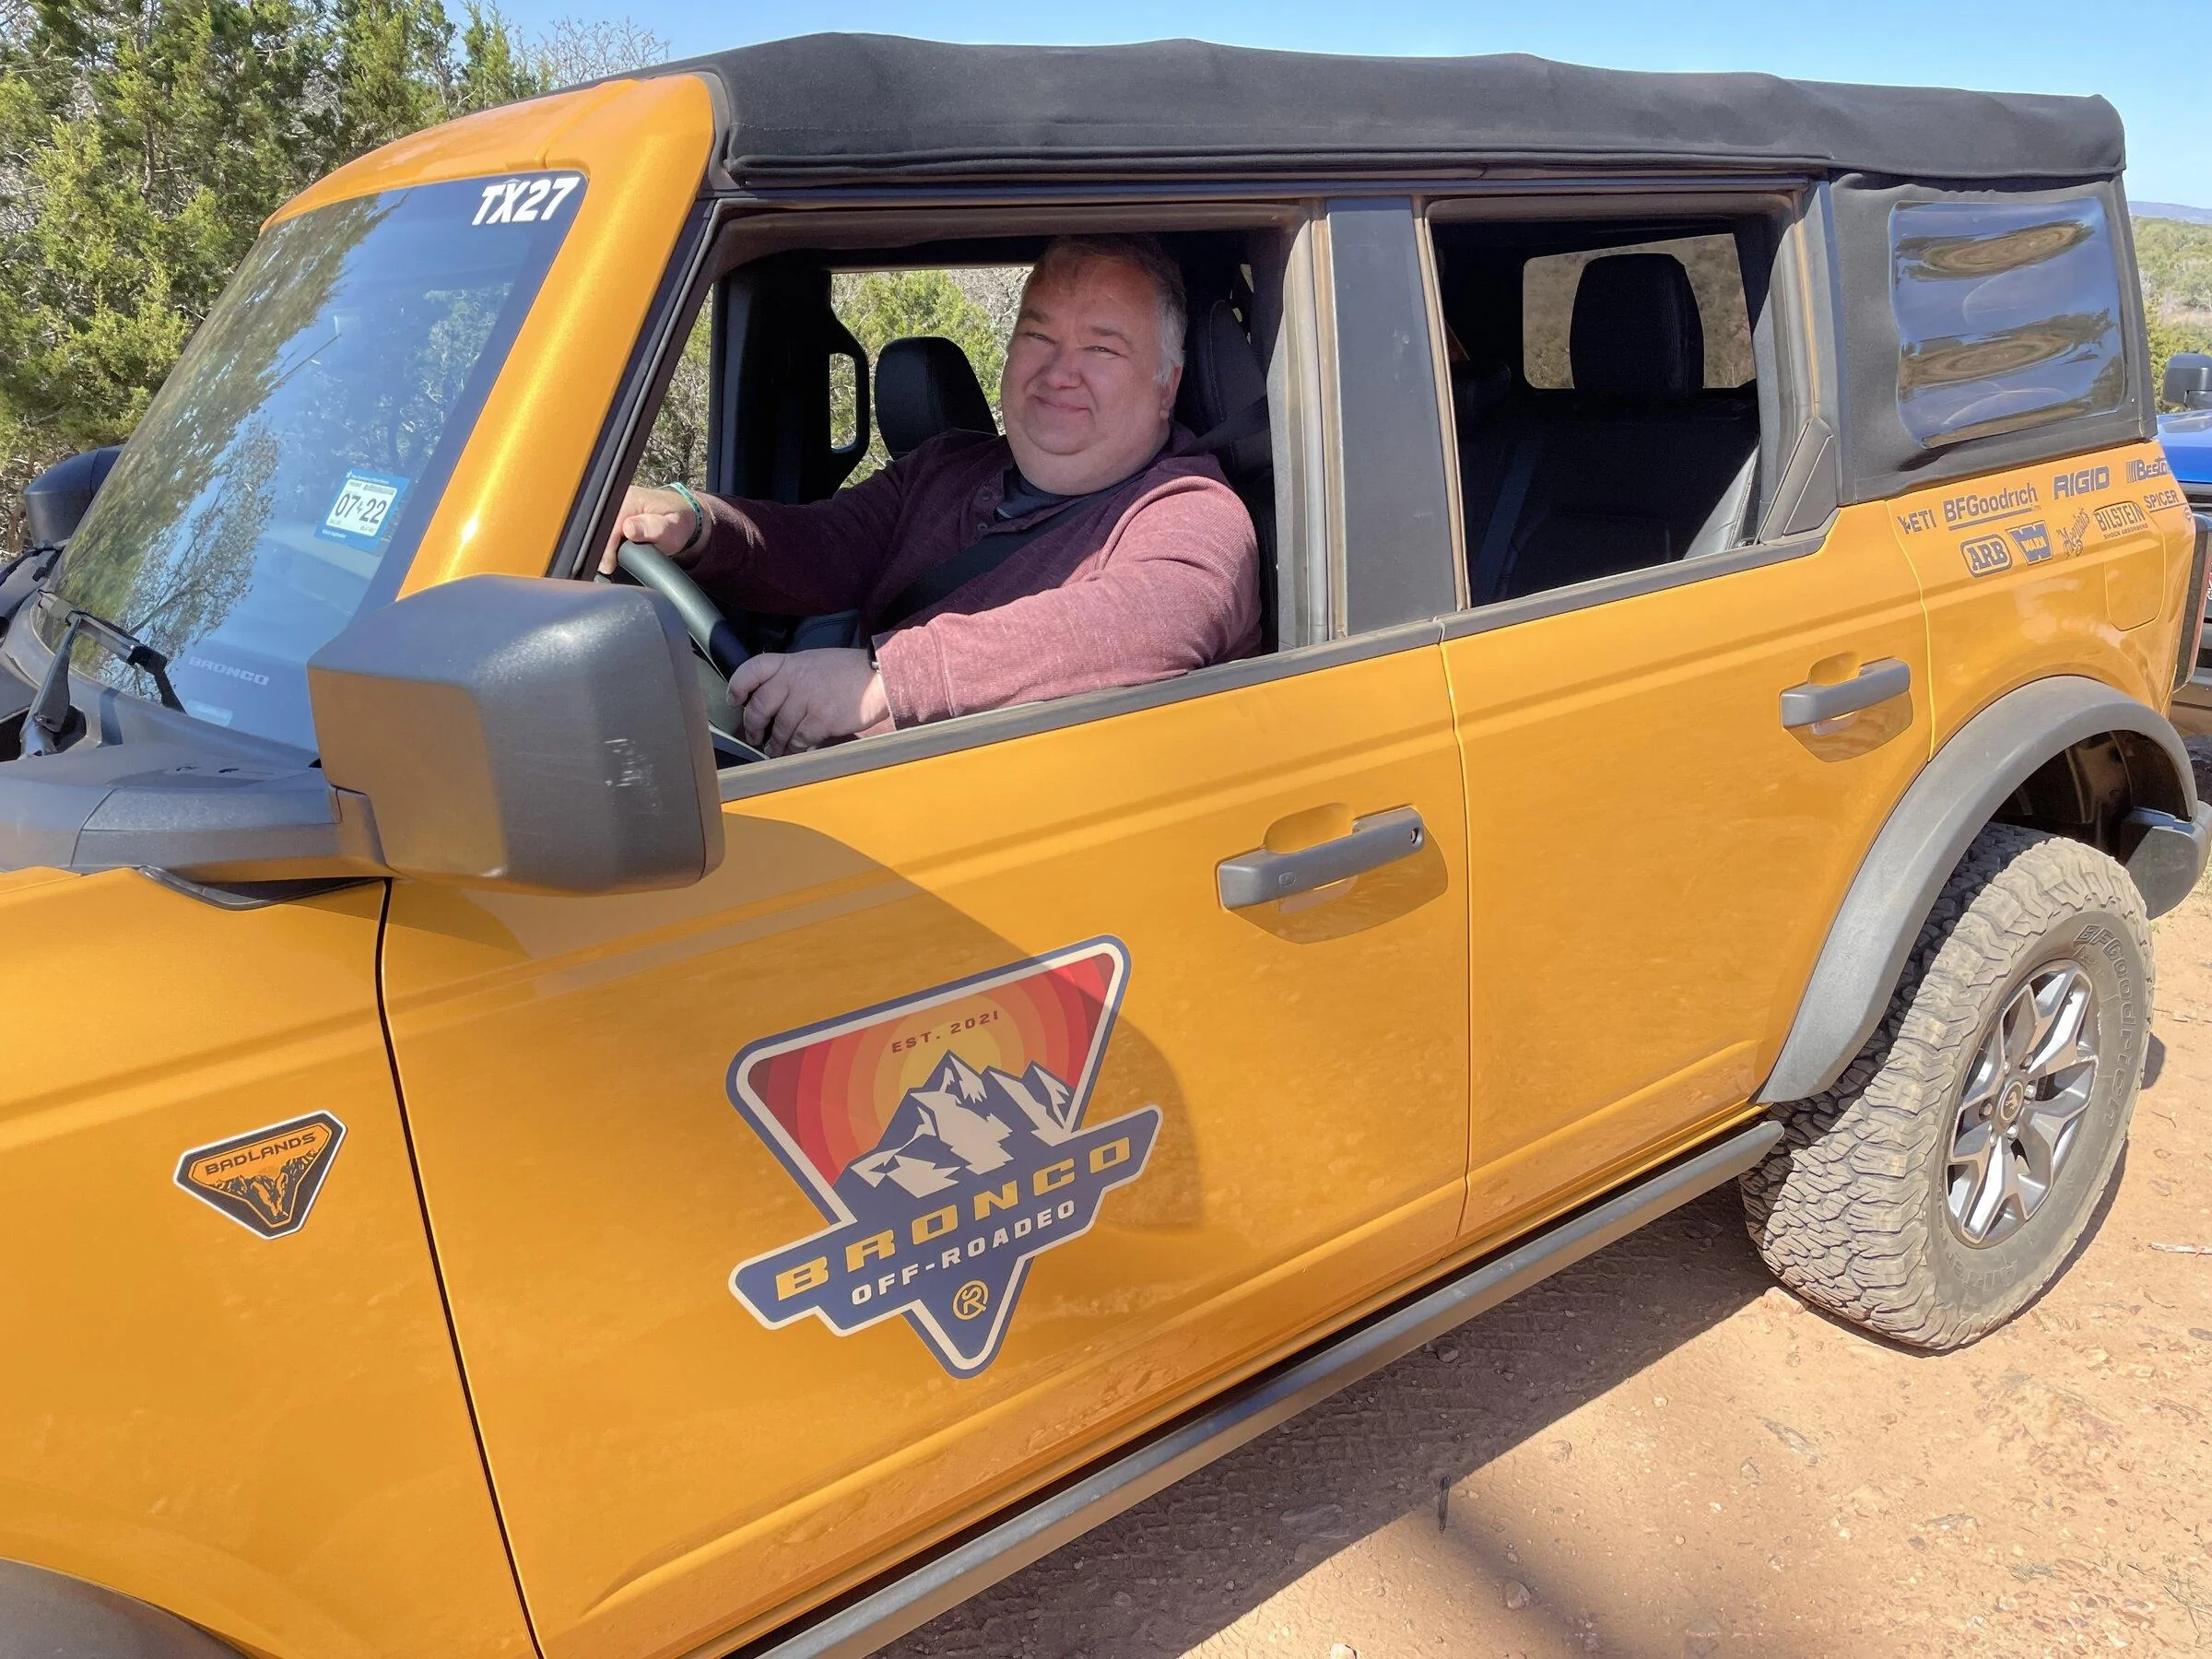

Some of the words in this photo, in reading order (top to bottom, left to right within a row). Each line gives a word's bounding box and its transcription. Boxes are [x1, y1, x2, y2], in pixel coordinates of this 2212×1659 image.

[471, 177, 581, 226] TX27
[2053, 465, 2110, 500] RIGID
[2143, 489, 2179, 509] SPICER
[335, 493, 361, 518] 07
[359, 498, 387, 524] 22
[1942, 482, 2039, 522] BFGoodrich
[2094, 503, 2146, 532] BILSTEIN
[1897, 509, 1937, 535] YETI
[1966, 540, 2008, 571] ARB
[188, 656, 270, 686] BRONCO
[892, 1031, 941, 1053] EST.
[950, 1010, 1000, 1035] 2021
[205, 1132, 316, 1175] BADLANDS
[775, 1137, 1131, 1301] BRONCO
[851, 1200, 1075, 1306] OFF-ROADEO
